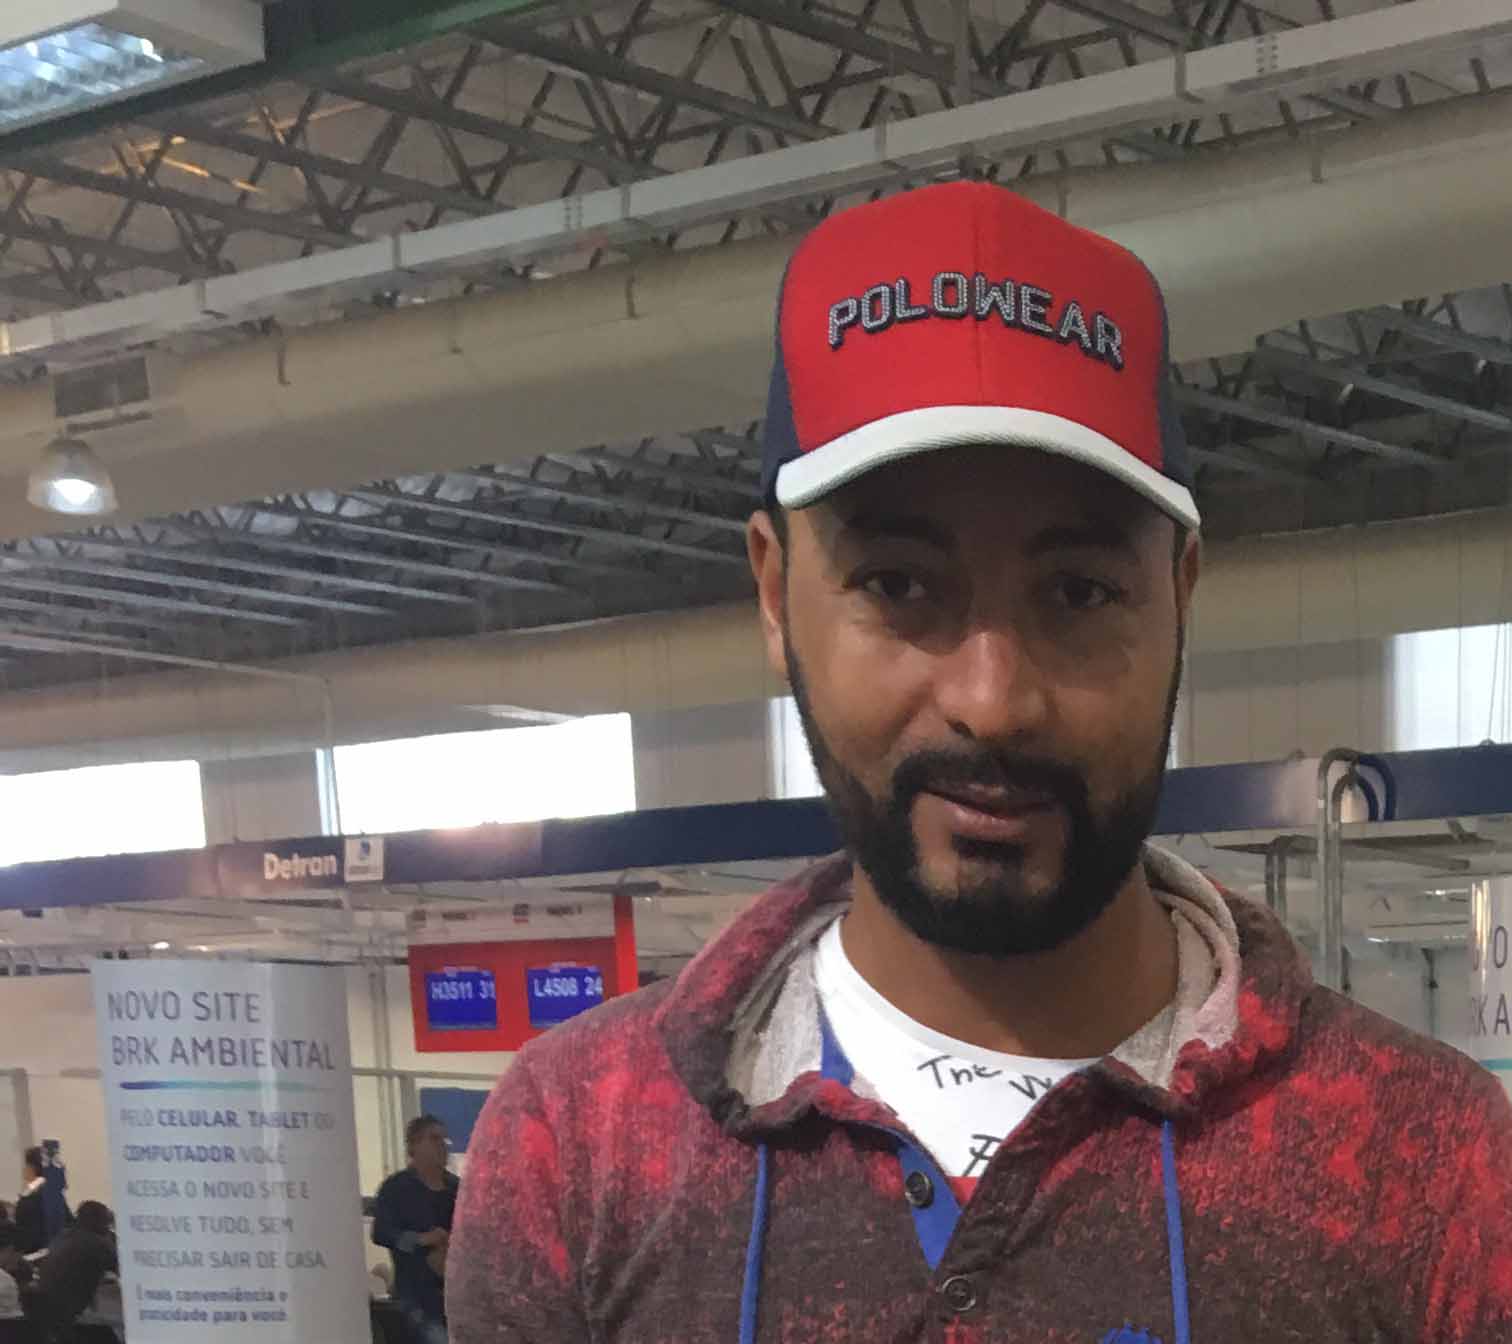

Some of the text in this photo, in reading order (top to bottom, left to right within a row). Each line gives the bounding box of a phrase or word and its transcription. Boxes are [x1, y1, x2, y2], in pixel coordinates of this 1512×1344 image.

[828, 270, 1124, 371] POLOWEAR
[264, 852, 336, 880] Detran
[107, 991, 260, 1023] NOVO SITE
[111, 1036, 335, 1070] BRK AMBIENTAL
[917, 1055, 1002, 1089] The
[248, 1111, 309, 1129] TABLET
[124, 1145, 235, 1163] COMPUTADOR
[203, 1181, 257, 1198] NOVO
